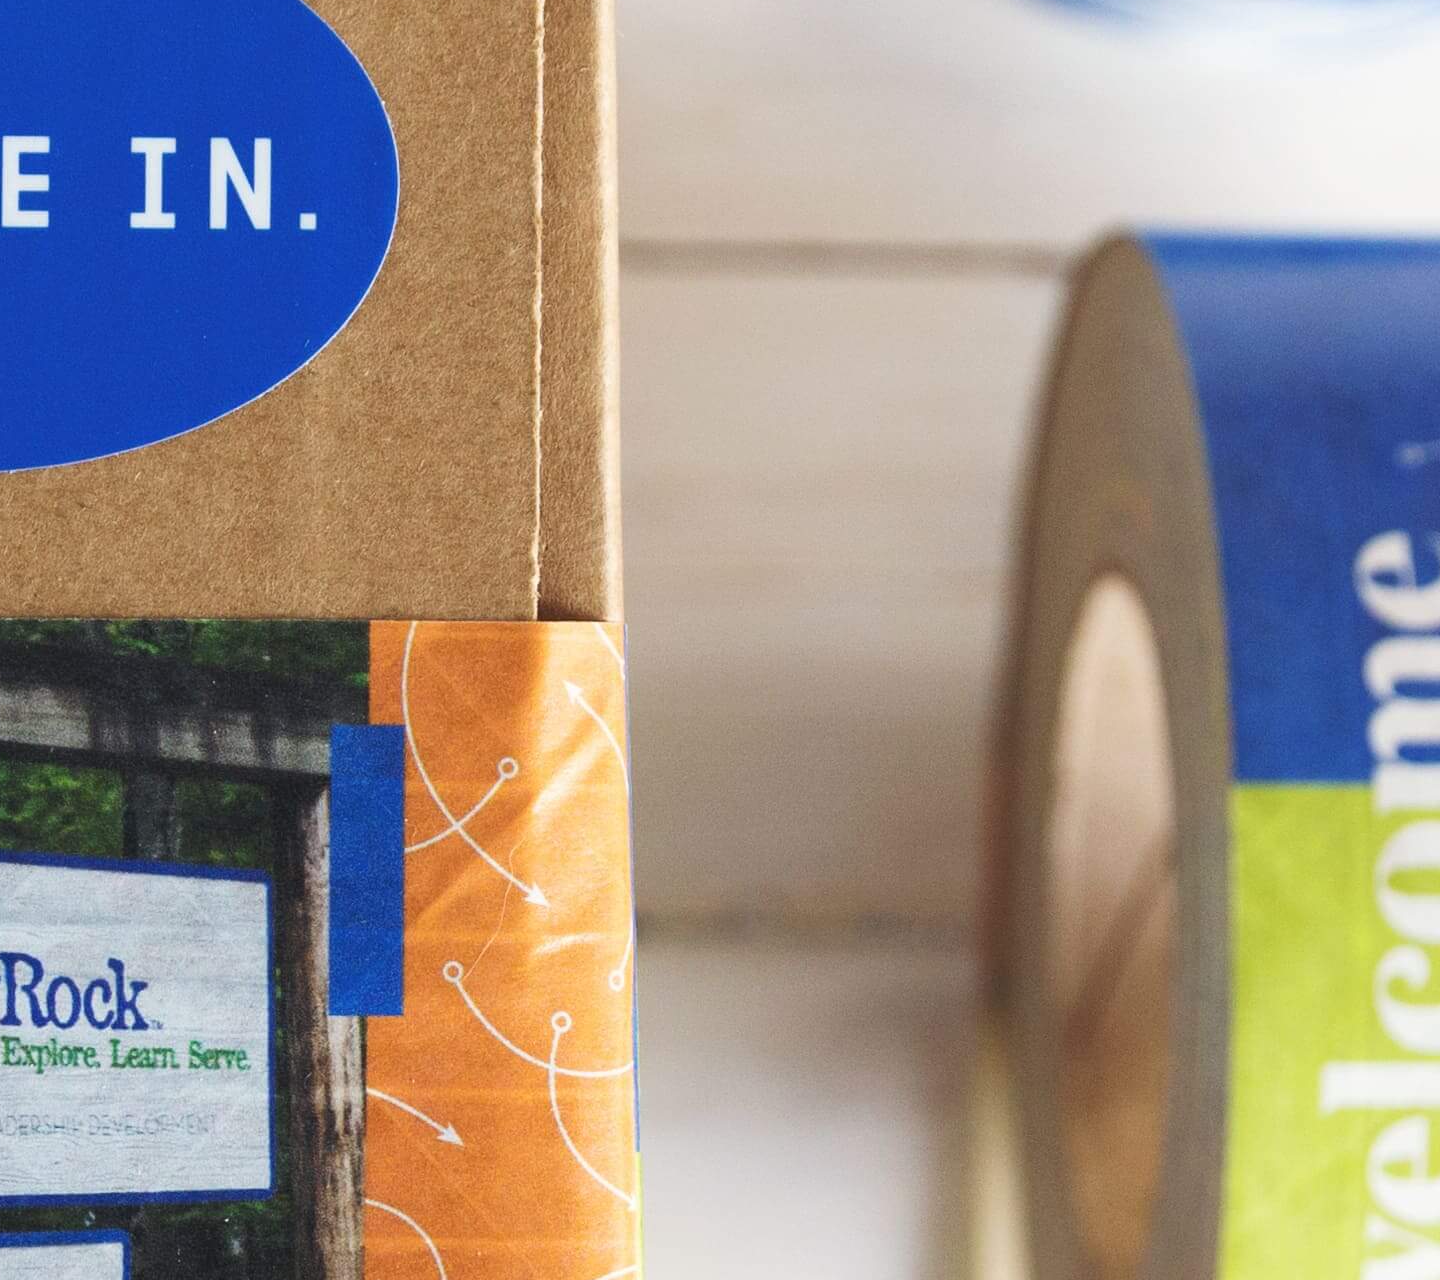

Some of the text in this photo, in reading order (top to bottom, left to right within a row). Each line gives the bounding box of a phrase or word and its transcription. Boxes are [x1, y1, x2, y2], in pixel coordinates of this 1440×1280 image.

[130, 137, 317, 230] IN.
[0, 1036, 101, 1074] Explore.
[188, 1040, 252, 1071] Serve.
